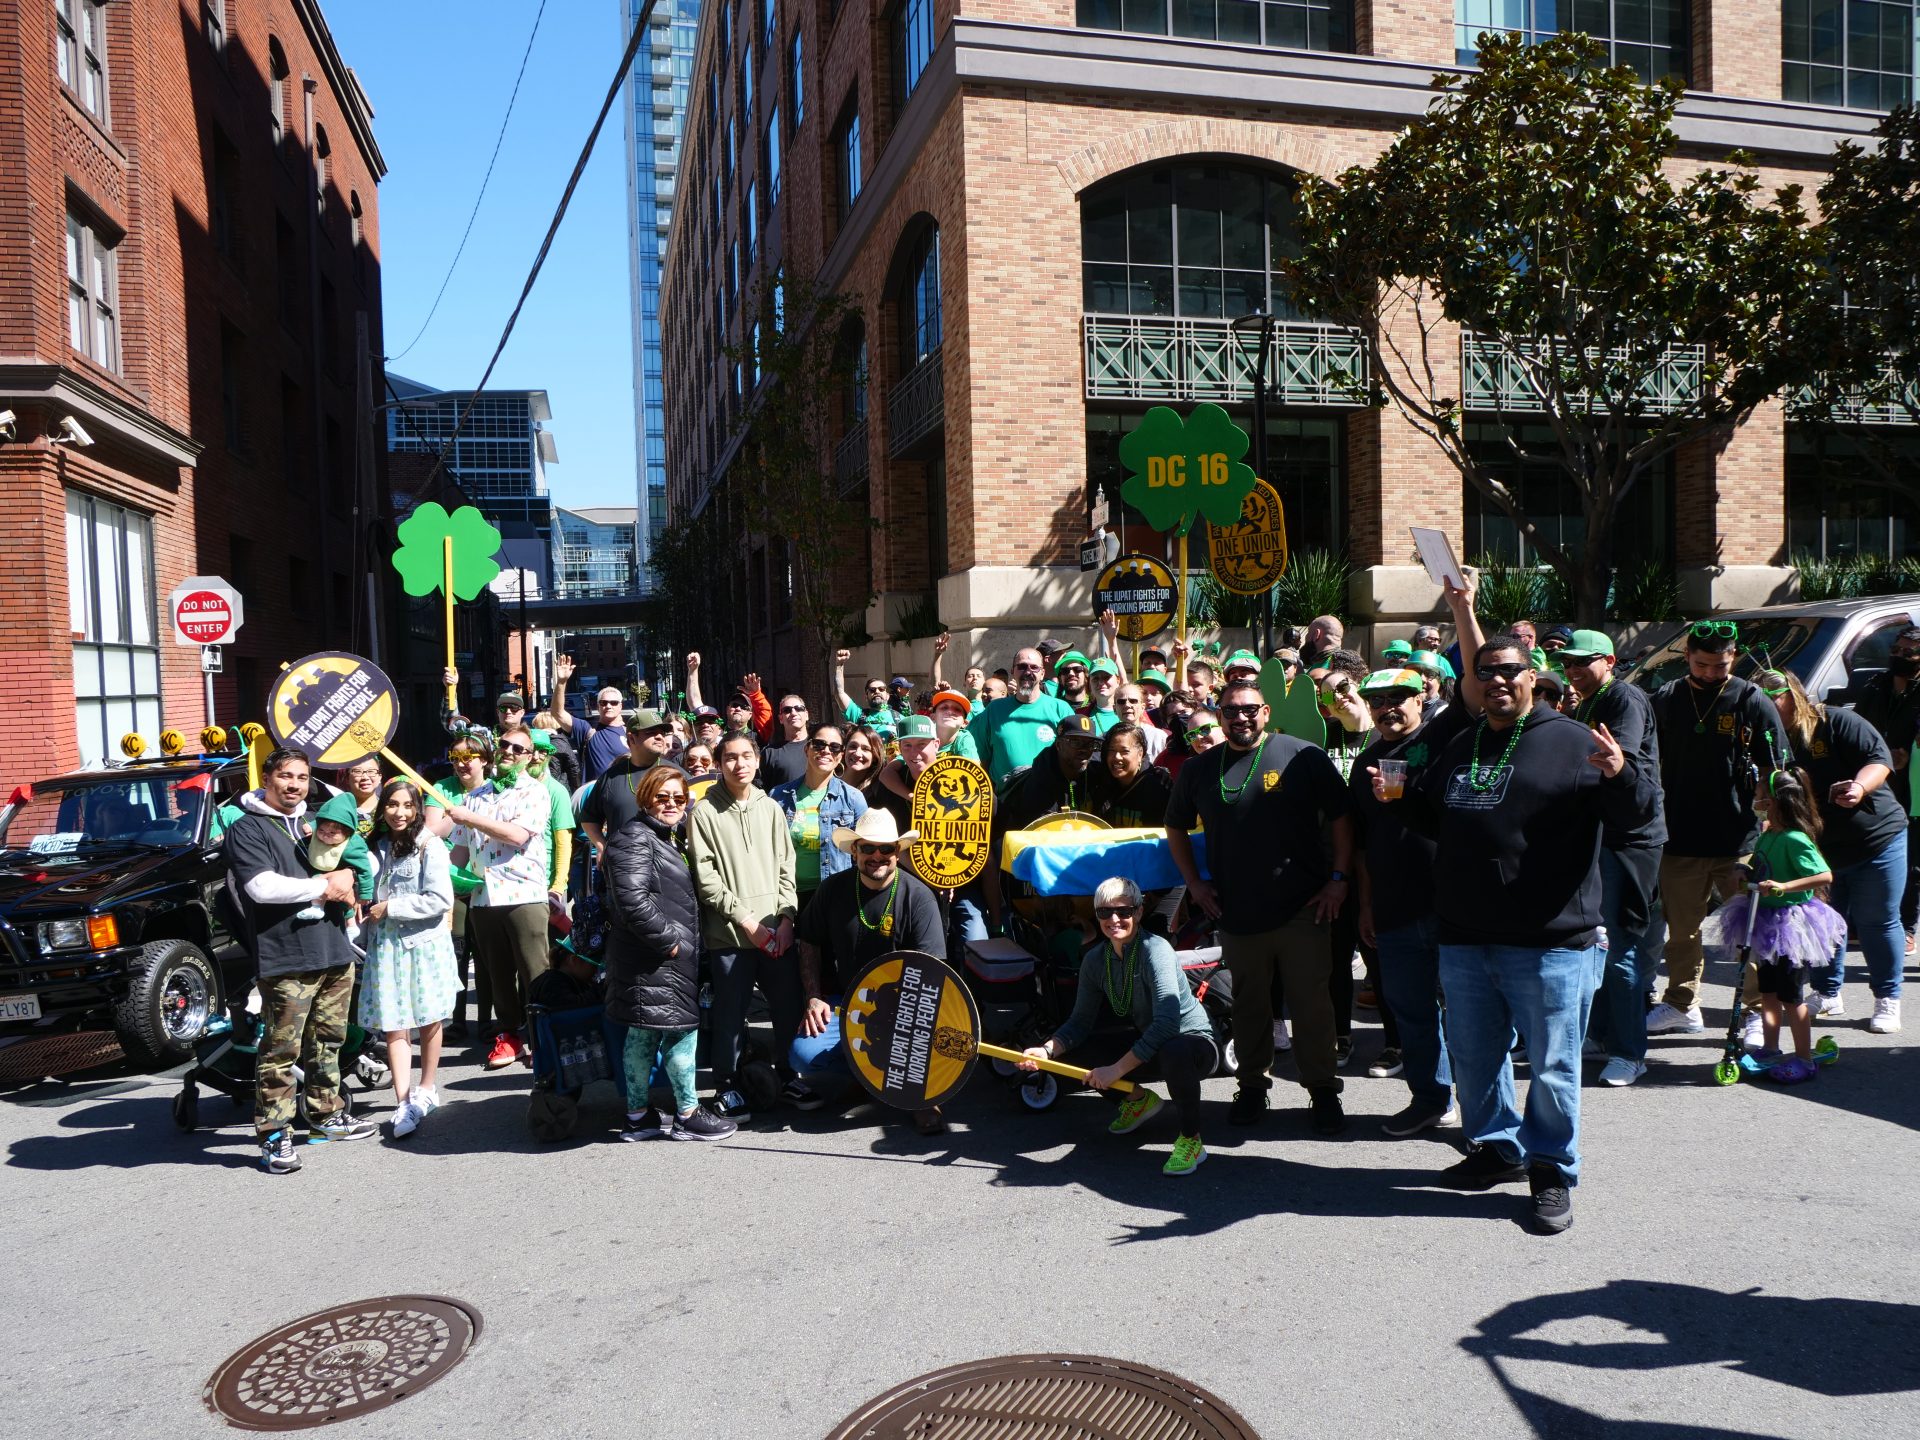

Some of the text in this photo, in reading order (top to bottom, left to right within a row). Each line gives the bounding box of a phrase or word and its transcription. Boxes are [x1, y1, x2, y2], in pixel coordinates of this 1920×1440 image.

[1148, 453, 1229, 488] DC 16
[1268, 499, 1280, 530] TRADES
[1215, 533, 1280, 557] ONE UNION
[1083, 549, 1093, 563] ONE
[1215, 551, 1281, 590] INTERNATIONAL UNION
[183, 600, 223, 610] DO NOT
[1100, 588, 1170, 602] THE IUPAT FIGHTS FOR
[1107, 601, 1163, 614] WORKING PEOPLE
[187, 624, 223, 633] ENTER
[290, 669, 371, 746] THE IUPAT FIGHTS FOR
[311, 711, 353, 751] WORKING
[344, 687, 377, 719] PEOPLE
[122, 735, 139, 754] KC
[161, 732, 177, 750] KC
[201, 729, 219, 747] KC
[243, 727, 259, 745] KC
[1328, 747, 1360, 758] BLN
[915, 759, 990, 819] PAINTERS AND ALLIED TRADES
[915, 820, 988, 841] ONE UNION
[913, 844, 988, 886] INTERNATIONAL UNION
[886, 966, 922, 1090] THE IUPAT FIGHTS FOR
[907, 983, 940, 1085] WORKING PEOPLE
